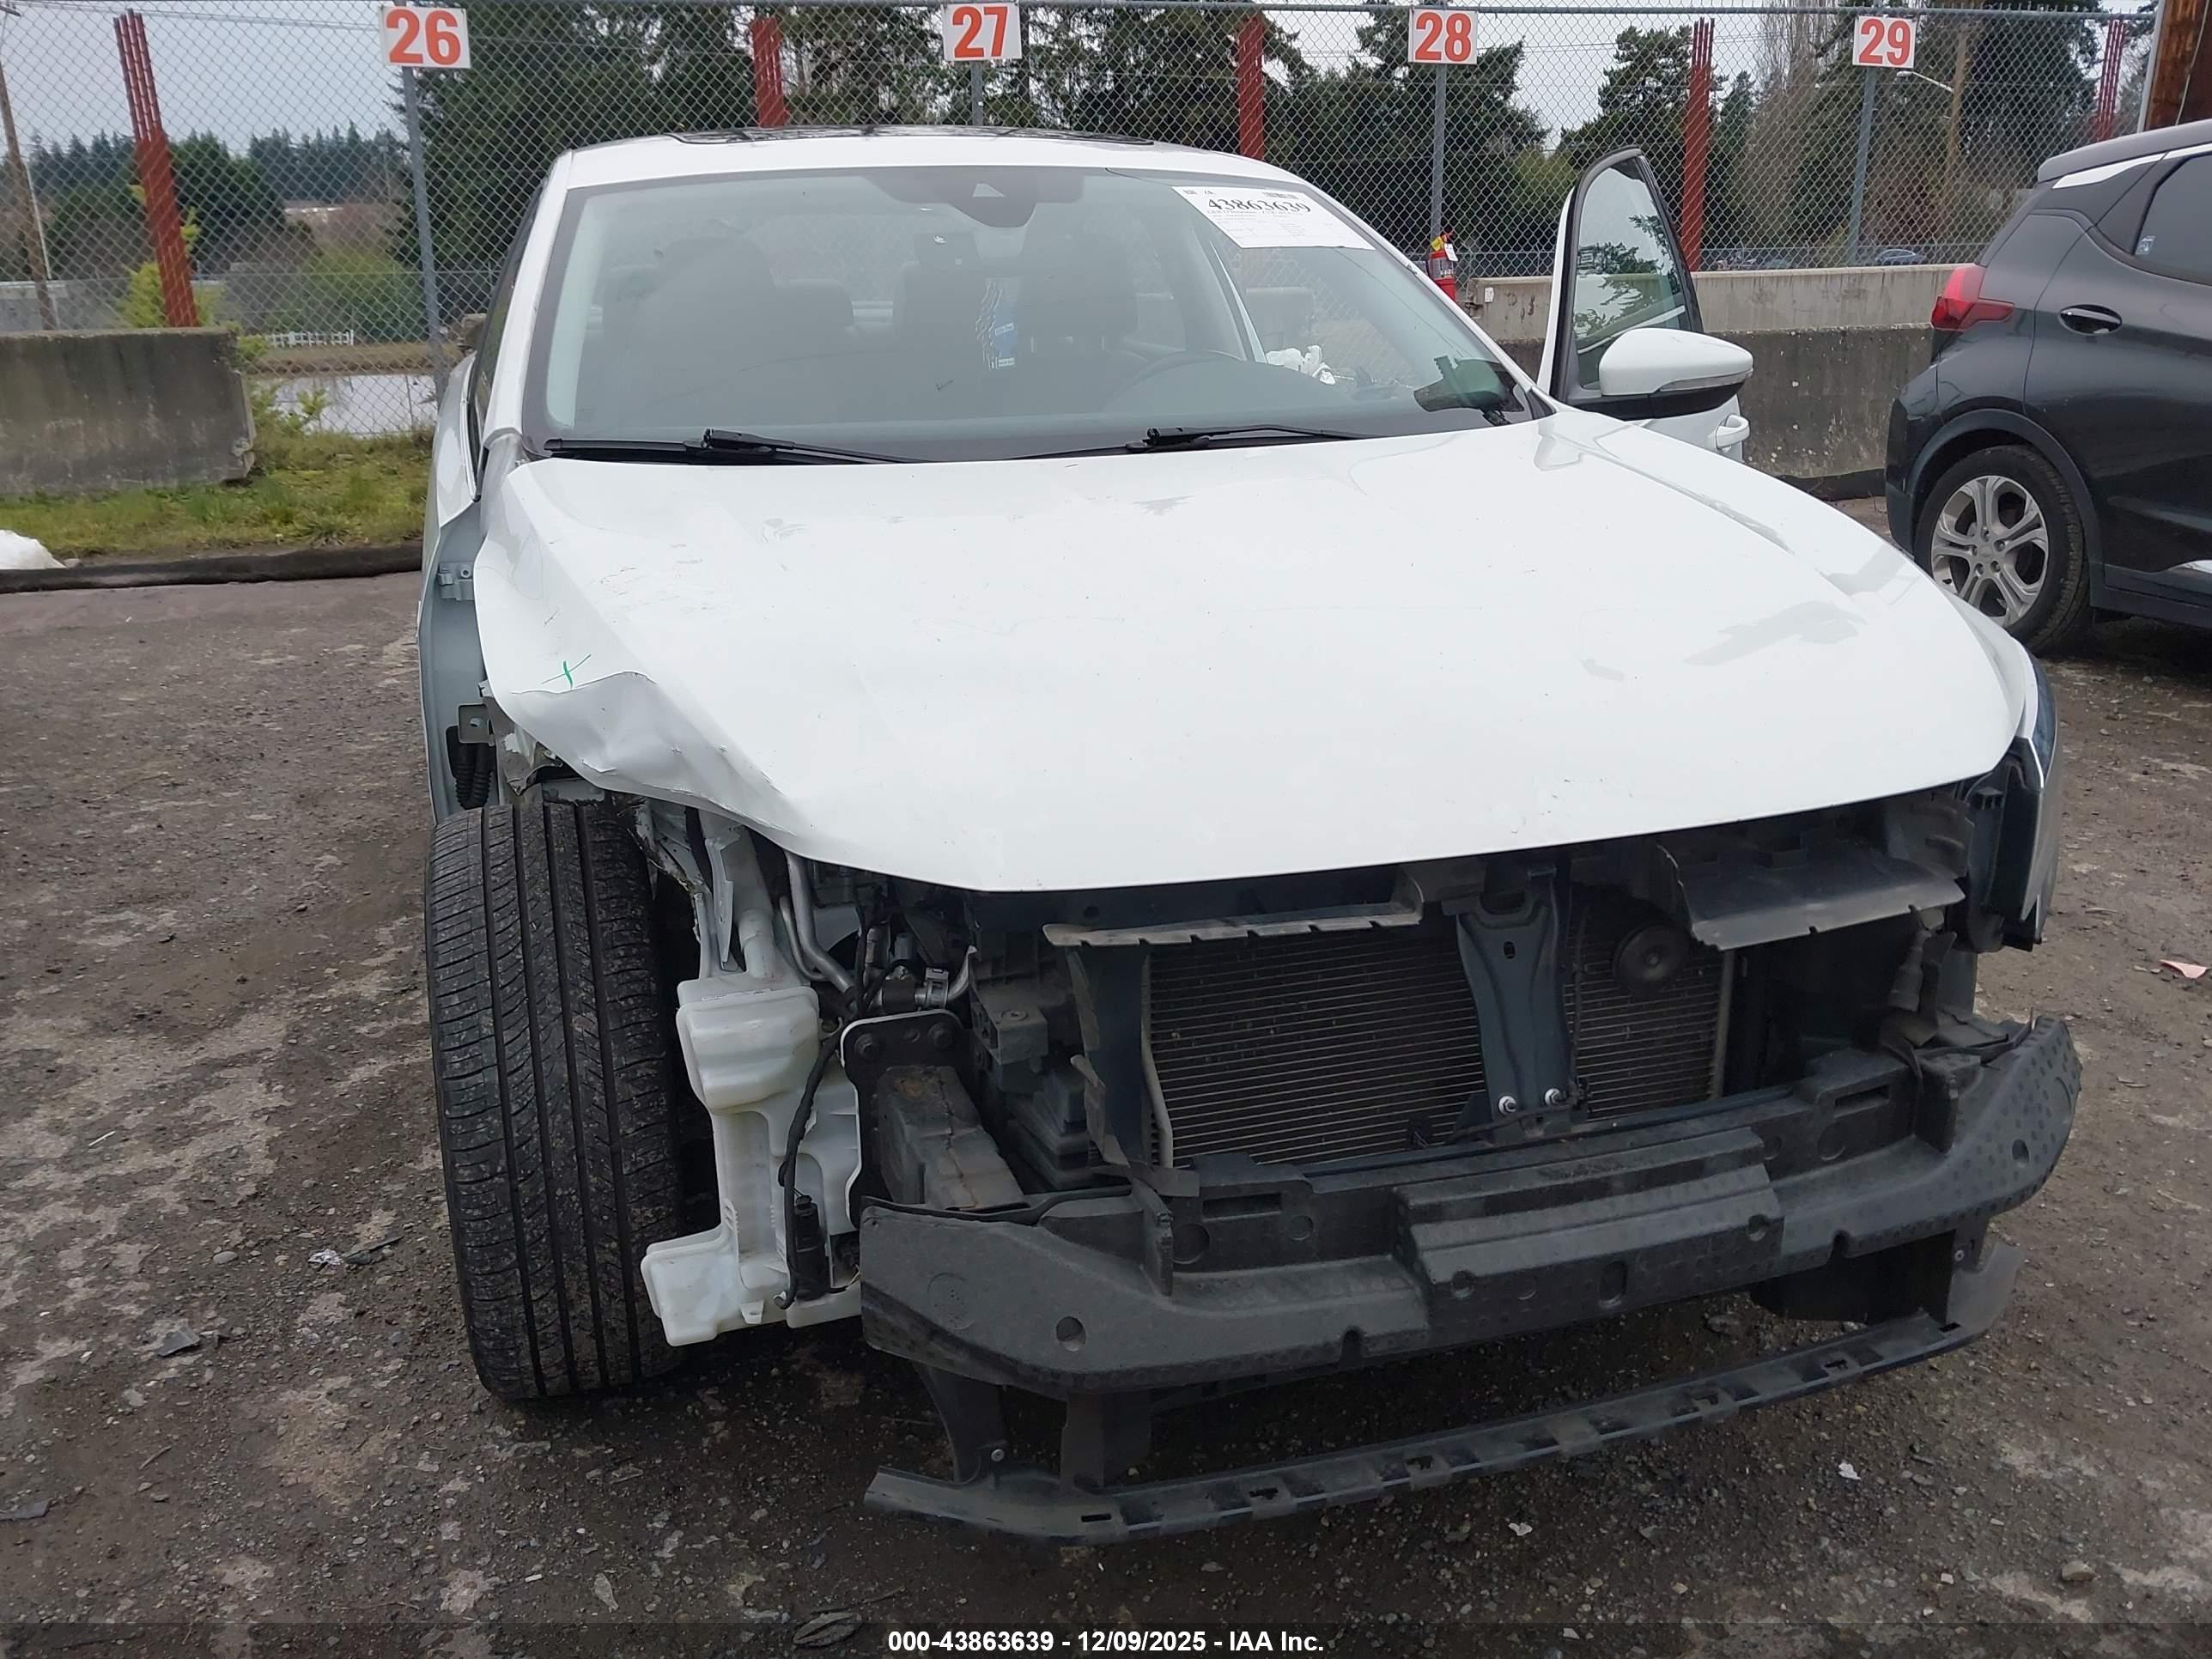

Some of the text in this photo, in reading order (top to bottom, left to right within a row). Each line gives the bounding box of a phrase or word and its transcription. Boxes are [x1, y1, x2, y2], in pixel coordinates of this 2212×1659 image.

[386, 9, 461, 65] 26
[951, 6, 1008, 59] 27
[1414, 11, 1472, 63] 28
[1858, 18, 1911, 66] 29
[1208, 198, 1311, 212] 43863639
